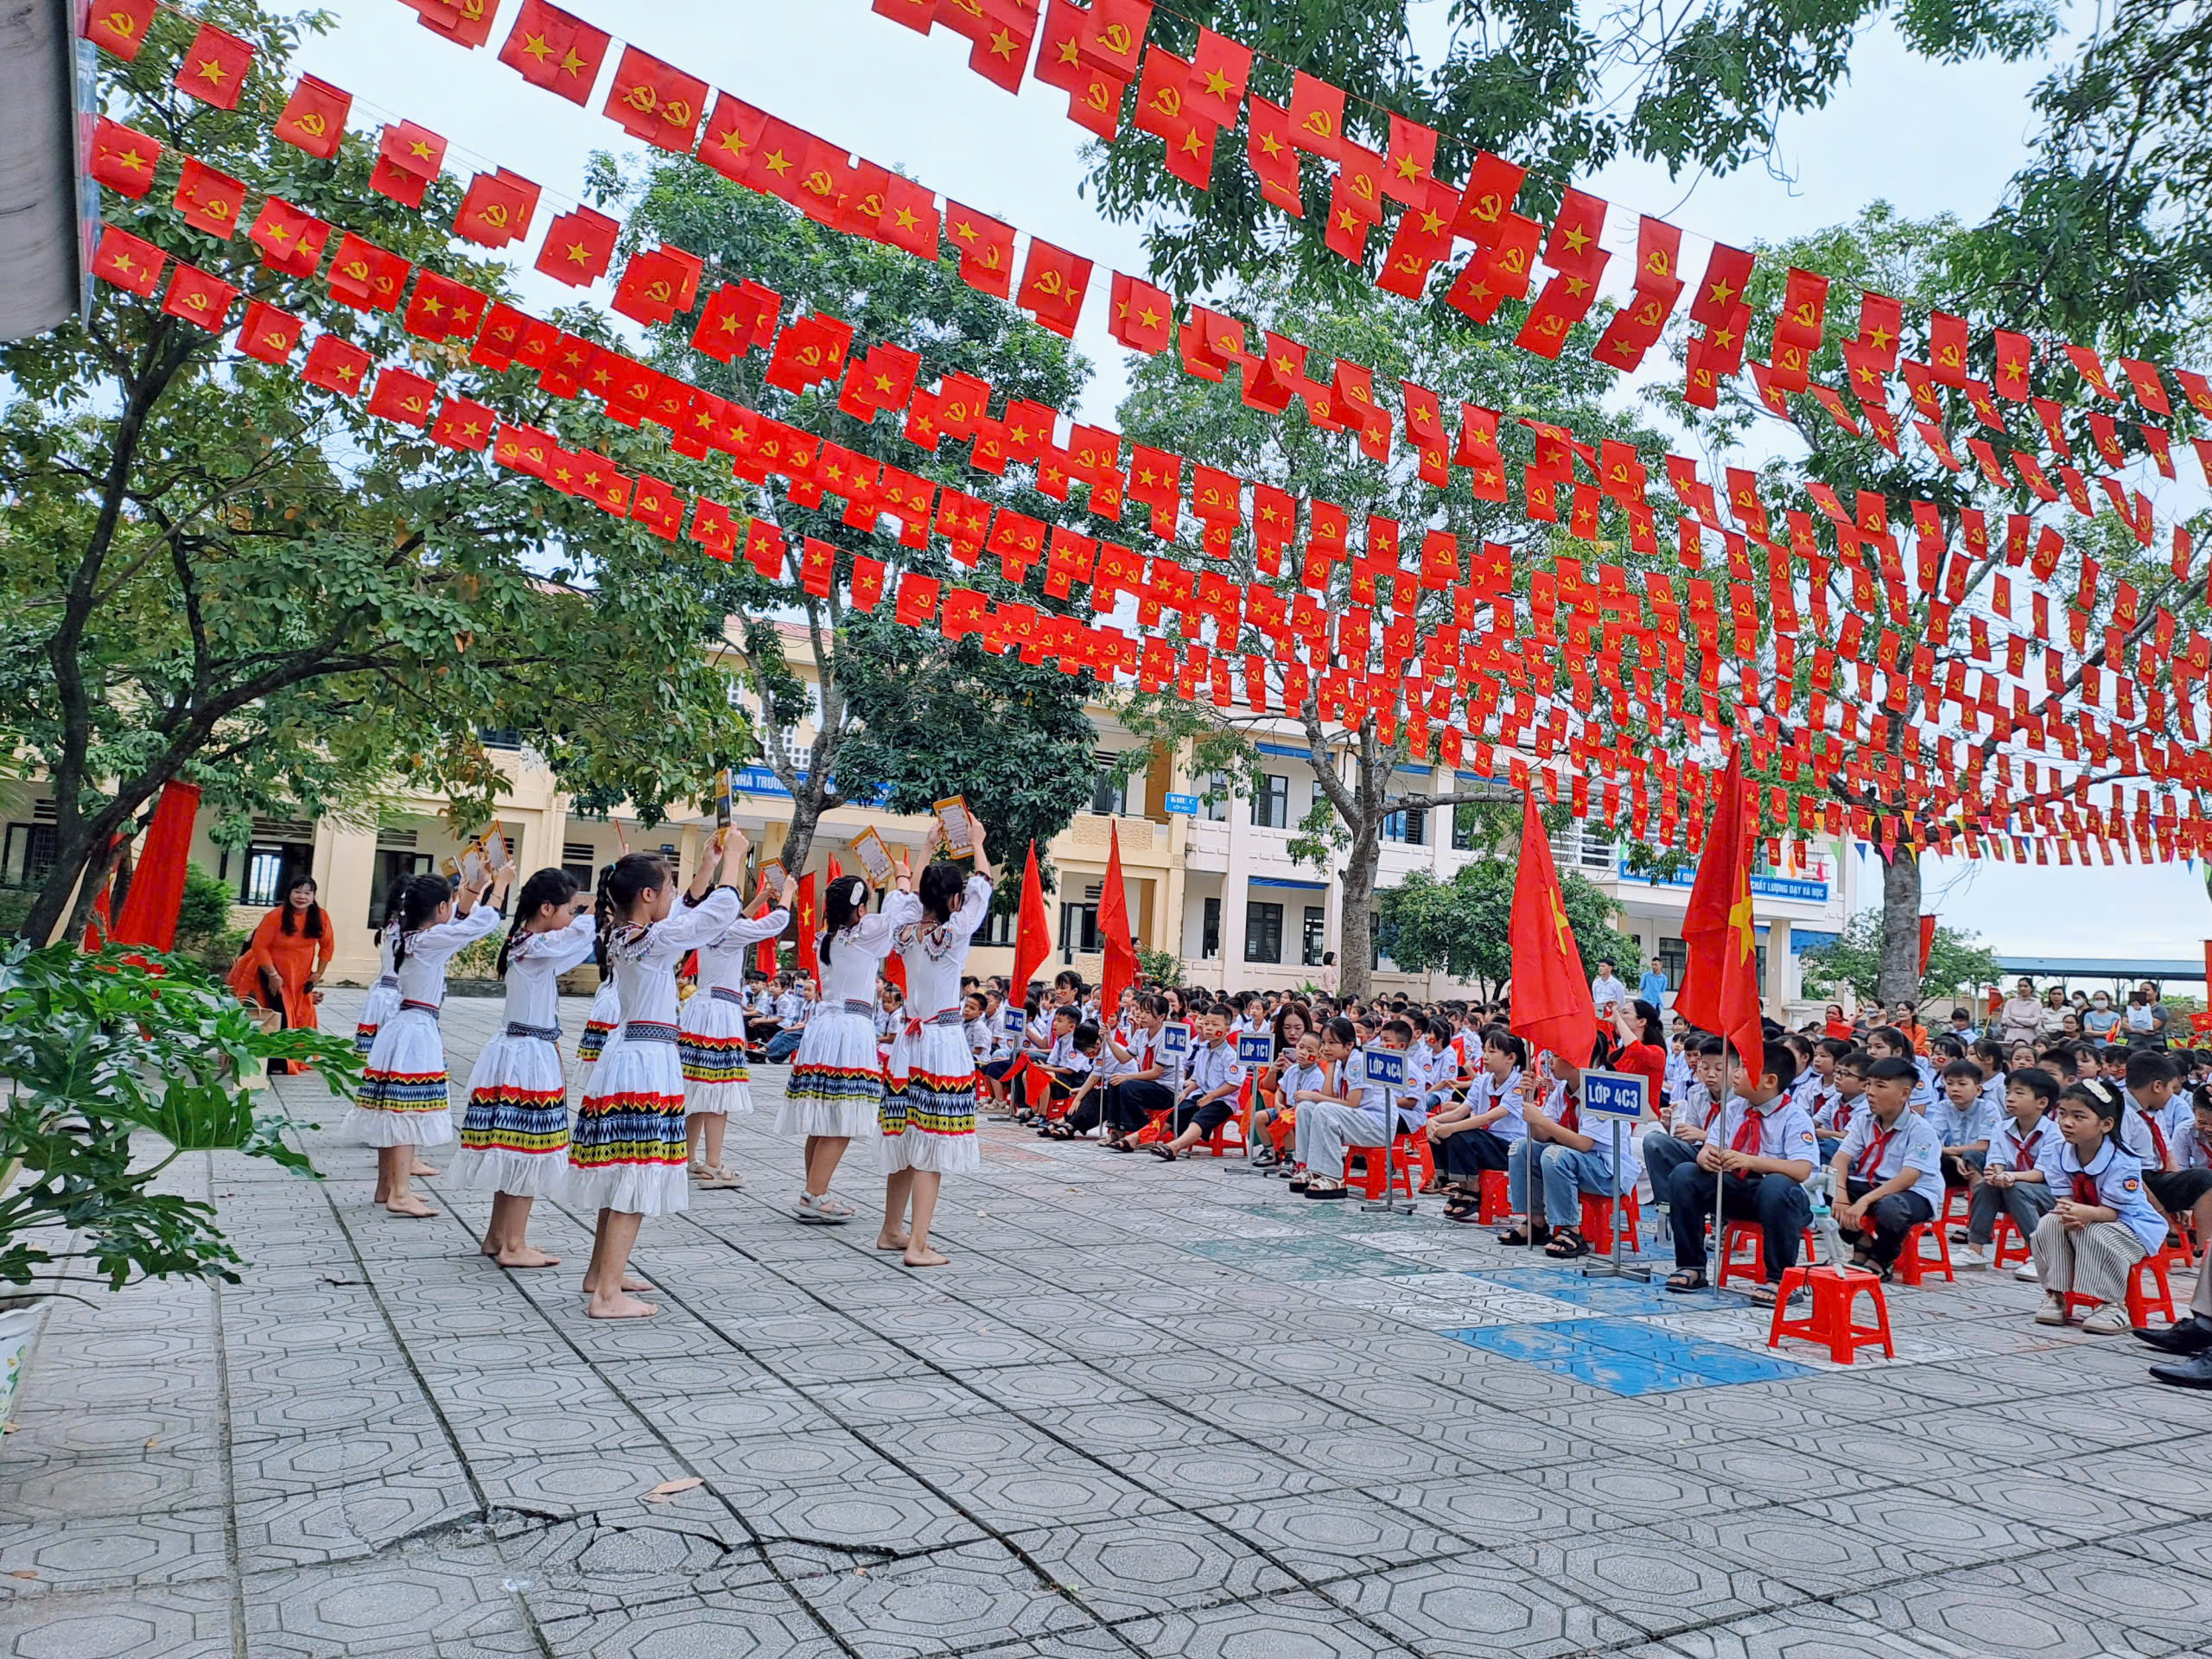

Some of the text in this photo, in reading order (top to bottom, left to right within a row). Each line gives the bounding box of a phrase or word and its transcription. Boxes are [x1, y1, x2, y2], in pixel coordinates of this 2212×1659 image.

[1166, 1030, 1185, 1047] LỚP 1C2
[1241, 1040, 1268, 1058] LỚP 1C1
[1369, 1056, 1402, 1079] LỚP 4C4
[1588, 1081, 1638, 1109] LỚP 4C3
